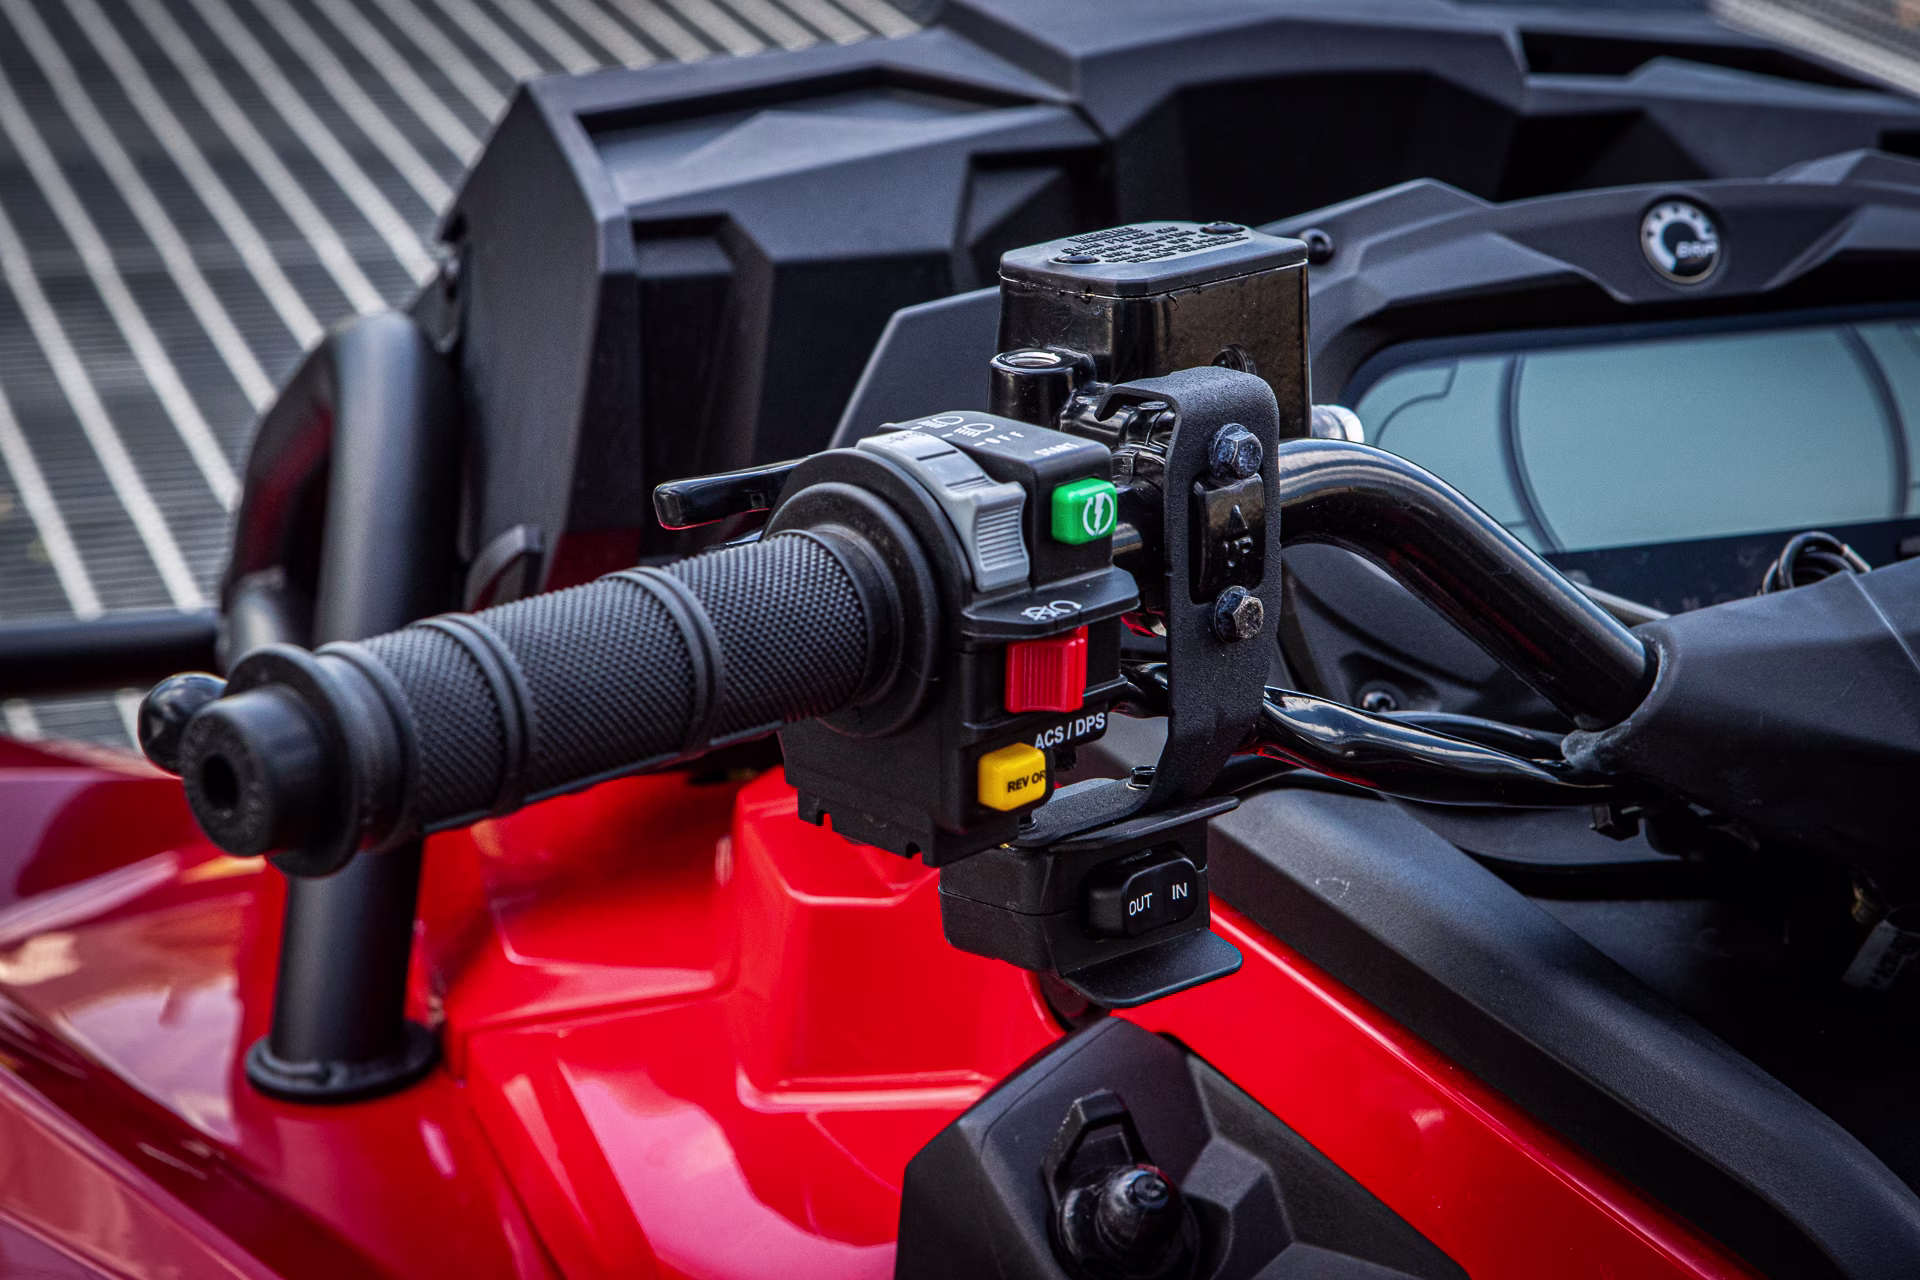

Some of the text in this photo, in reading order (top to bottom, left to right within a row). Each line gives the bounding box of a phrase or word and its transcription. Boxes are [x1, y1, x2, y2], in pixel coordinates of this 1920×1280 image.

[985, 431, 1024, 444] OFF
[1034, 442, 1079, 457] START
[1034, 712, 1106, 749] ACS / DPS
[1007, 775, 1030, 793] REV
[1129, 882, 1188, 916] OUT IN
